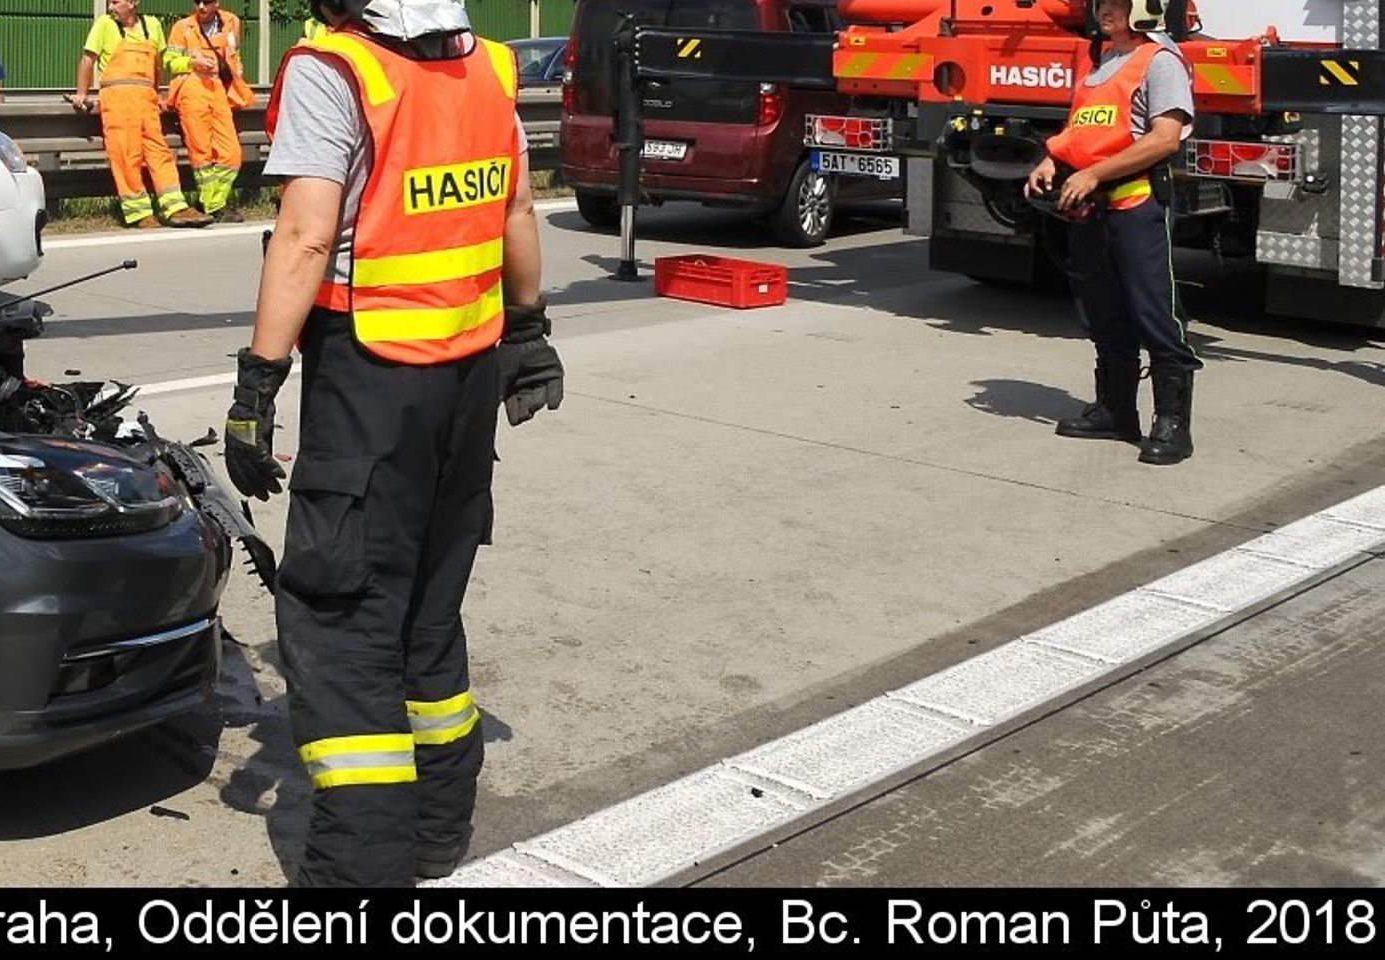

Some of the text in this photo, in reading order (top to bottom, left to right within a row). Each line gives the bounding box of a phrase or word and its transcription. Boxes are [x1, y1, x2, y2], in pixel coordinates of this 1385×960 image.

[989, 62, 1073, 88] HASIČI
[822, 153, 847, 170] 5AT
[858, 157, 893, 174] 6565
[410, 161, 506, 209] HASIČI
